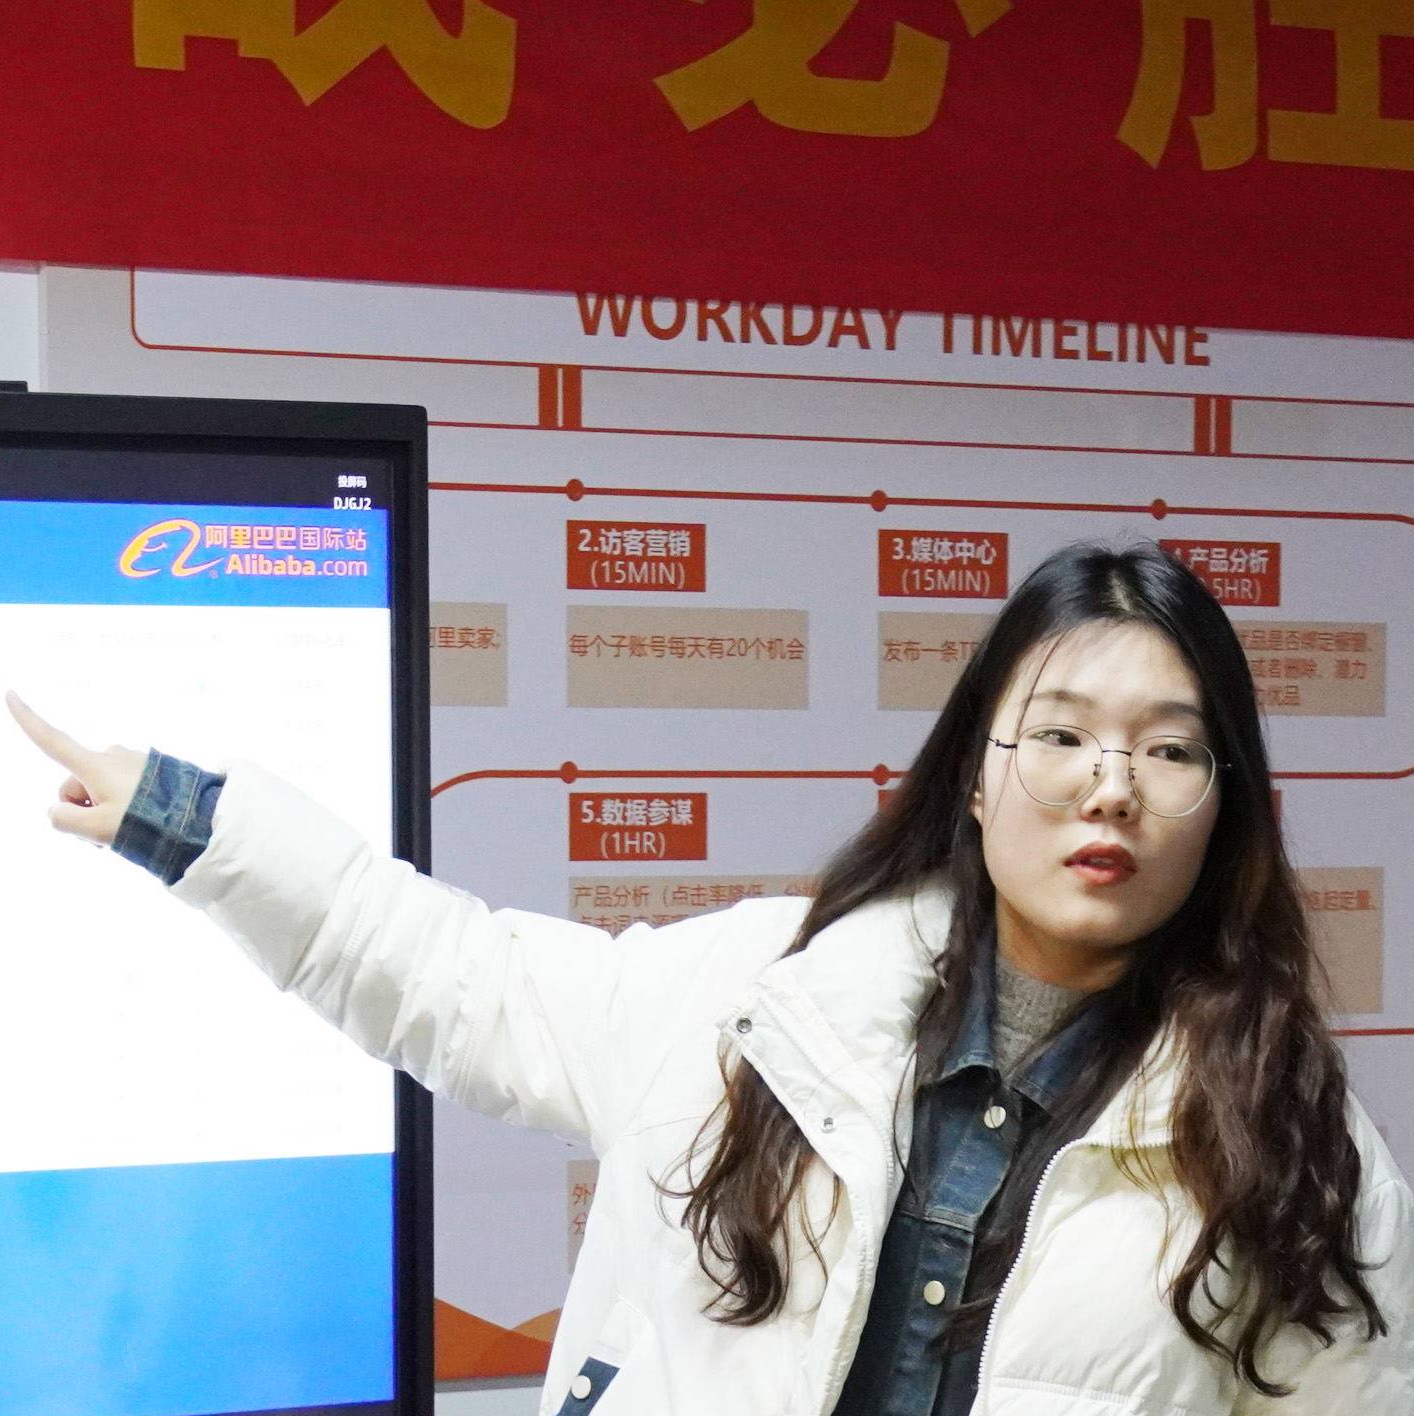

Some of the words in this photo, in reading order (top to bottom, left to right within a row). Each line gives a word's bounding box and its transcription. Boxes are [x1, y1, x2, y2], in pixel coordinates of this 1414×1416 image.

[576, 294, 903, 351] WORKDAY
[941, 311, 1210, 367] TIMELINE
[204, 525, 367, 552] 阿里巴巴国际站
[577, 528, 691, 559] 2.访客营销
[891, 537, 996, 566] 3.媒体中心
[226, 554, 368, 577] Alibaba.com
[1174, 546, 1269, 574] 产品分析
[590, 560, 686, 590] (15MIN)
[901, 568, 991, 597] (15MIN)
[569, 633, 806, 661] 每个子账号每天有20个机会
[581, 798, 694, 827] 5.数据参谋
[600, 831, 666, 859] (1HR)
